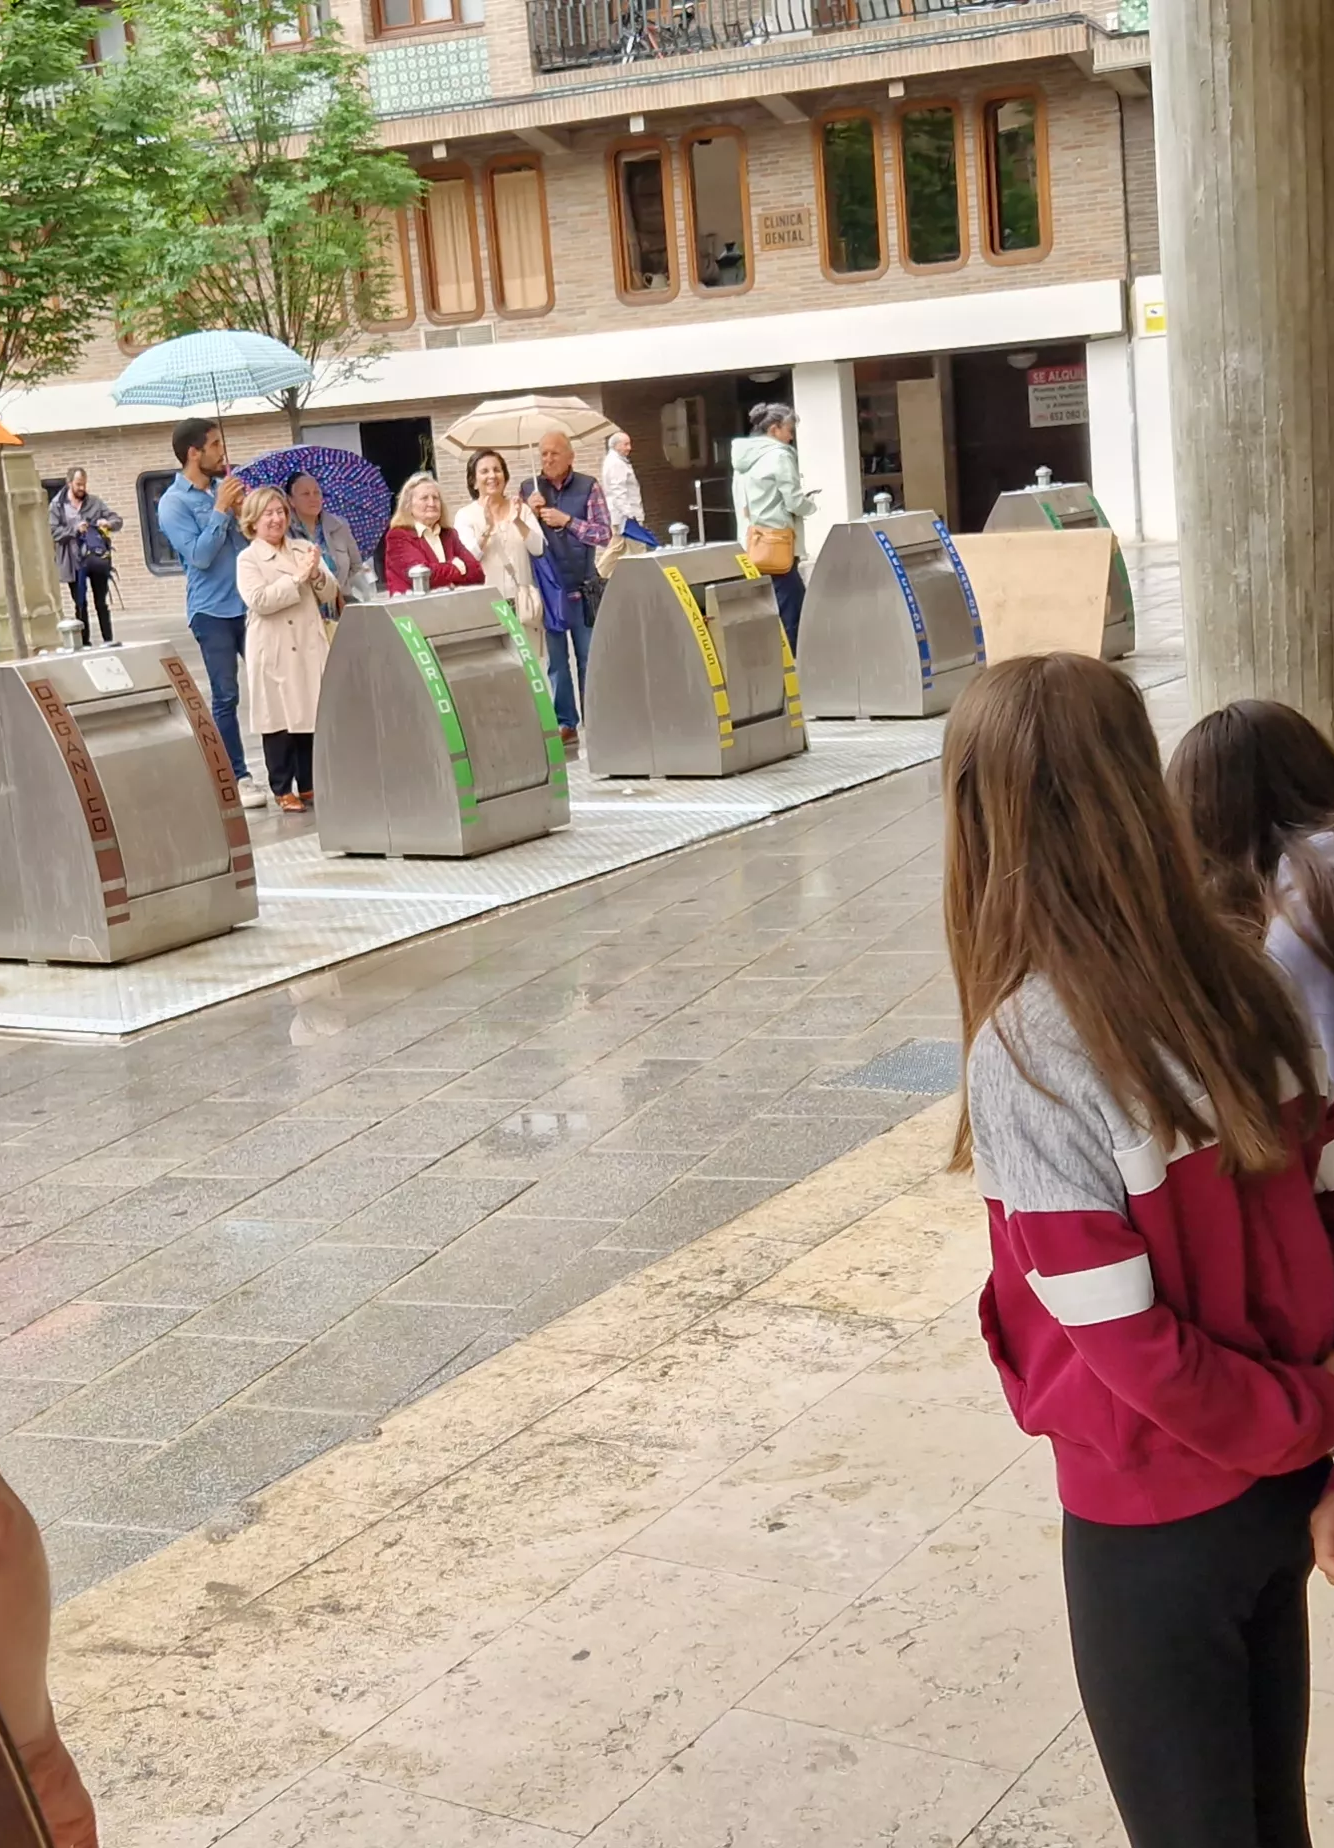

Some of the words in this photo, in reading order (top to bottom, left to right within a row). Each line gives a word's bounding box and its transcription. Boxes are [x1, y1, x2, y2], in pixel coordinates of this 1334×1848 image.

[765, 230, 805, 245] DENTAL
[1033, 371, 1046, 384] SE
[878, 533, 904, 575] PAPEL
[901, 577, 922, 631] CARTON
[935, 522, 959, 562] PAPEL
[495, 604, 545, 694] VIDRIO
[669, 572, 716, 666] ENVASES
[400, 620, 452, 714] VIDRIO
[34, 685, 108, 834] ORGANICO
[168, 662, 237, 803] ORGANICO
